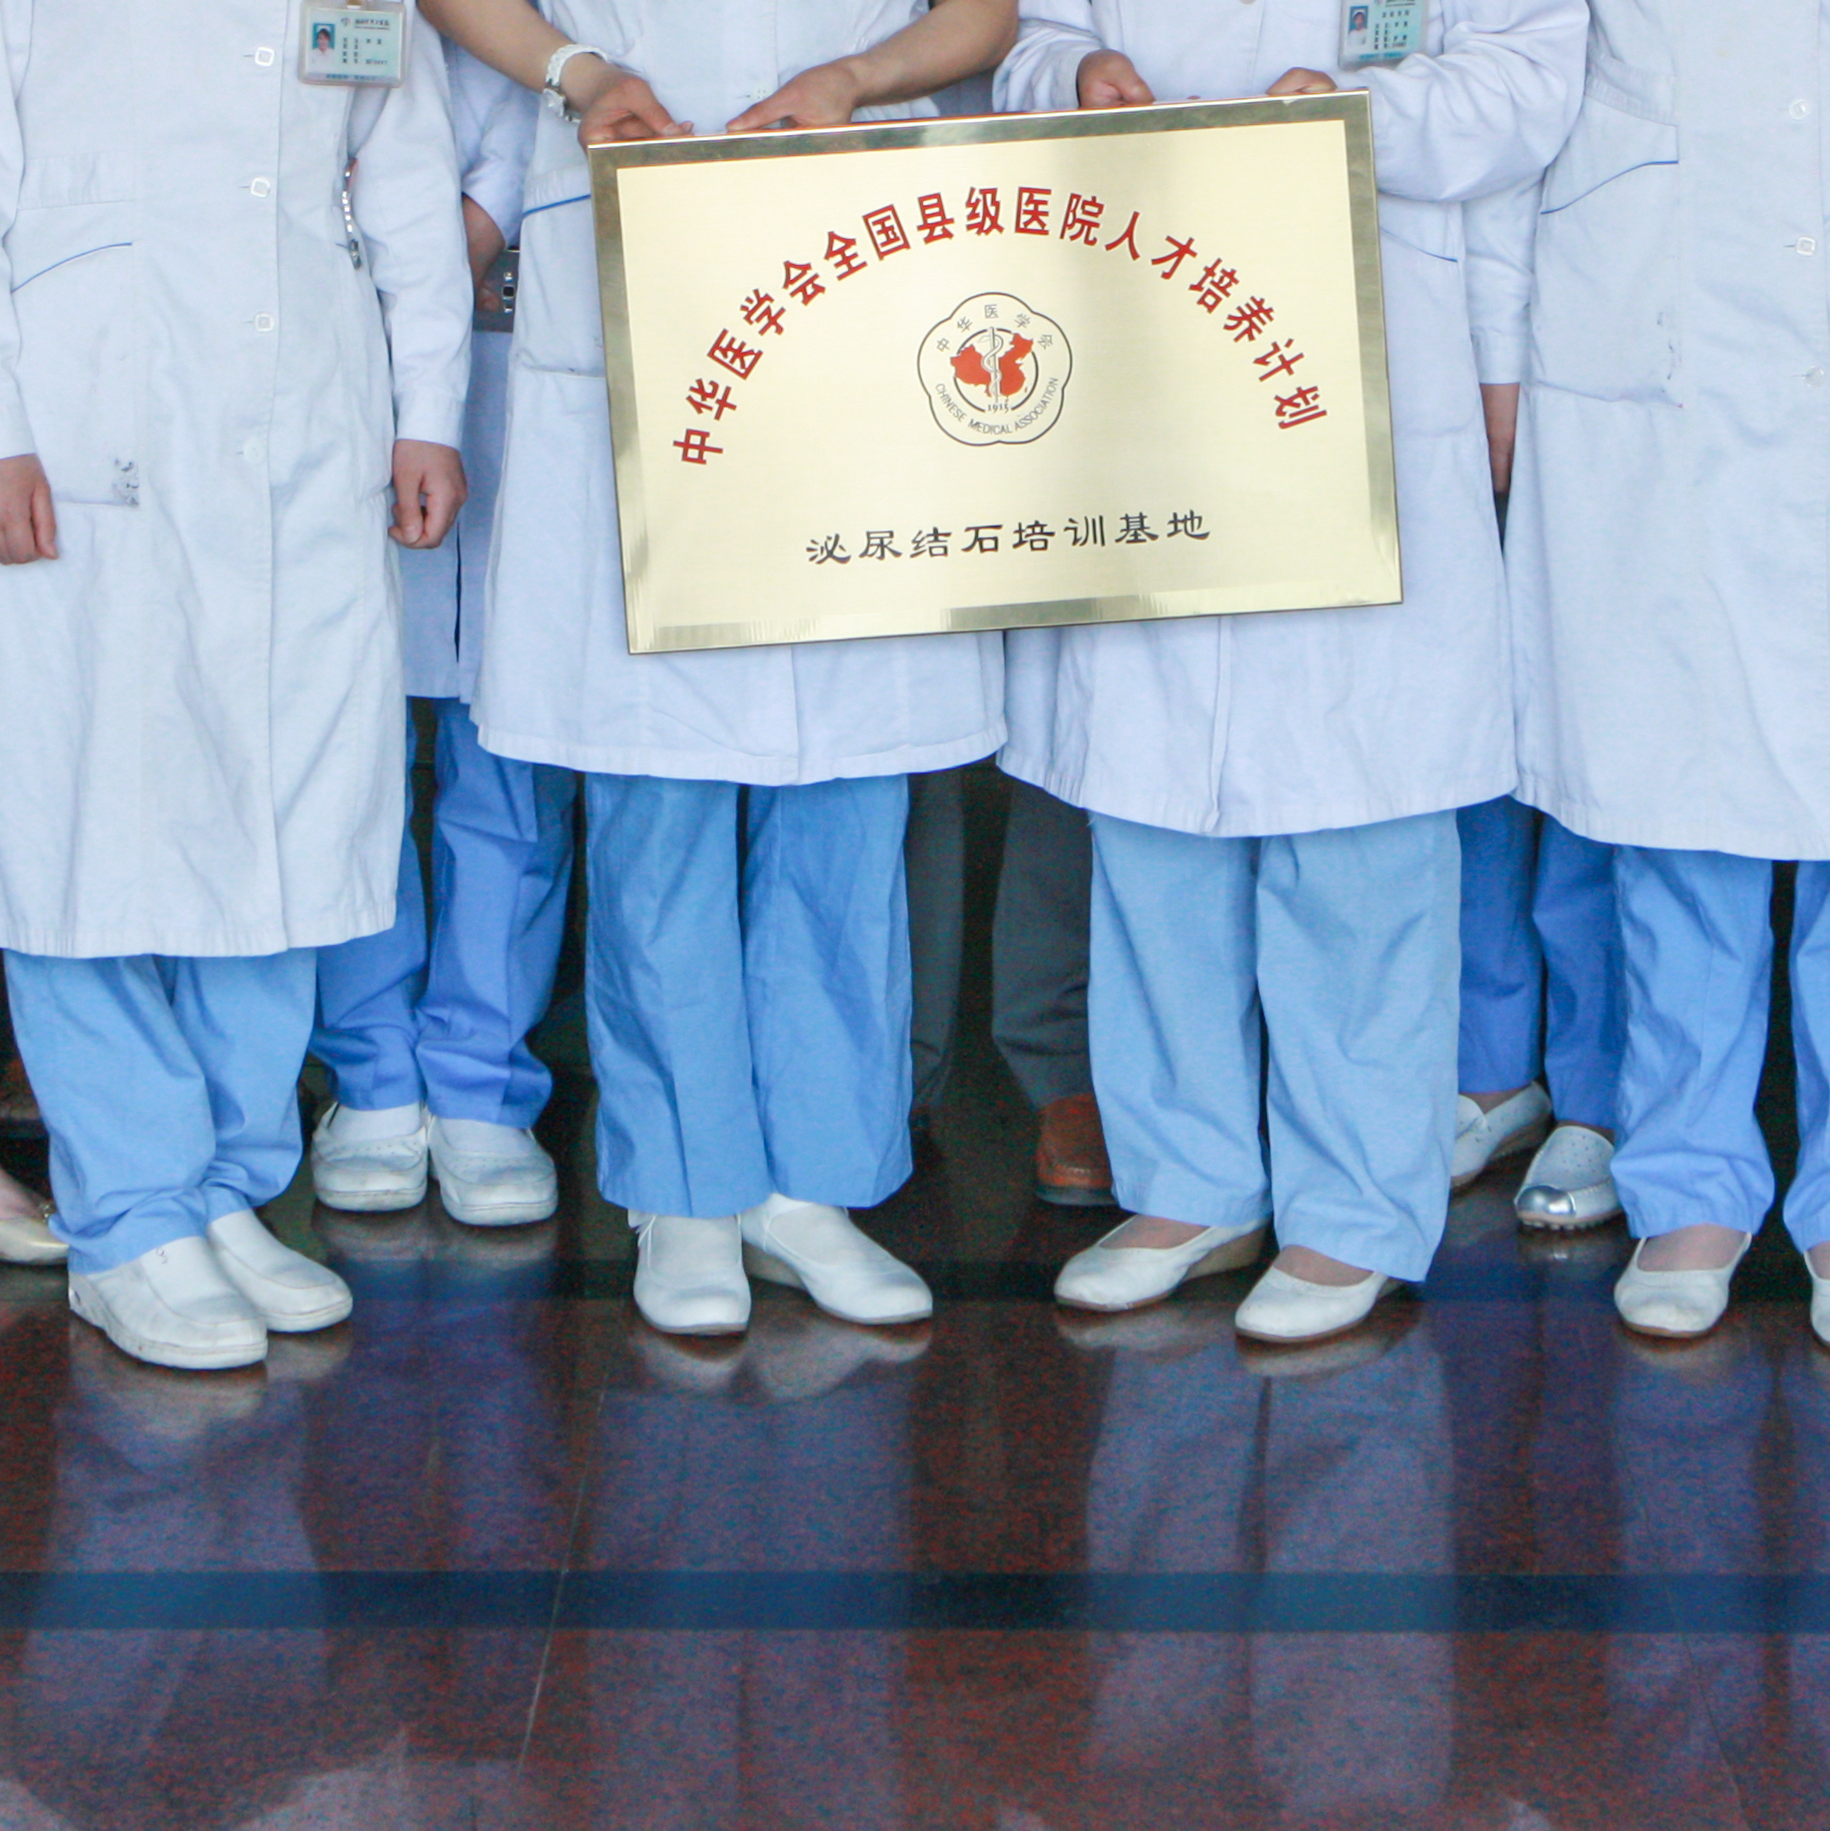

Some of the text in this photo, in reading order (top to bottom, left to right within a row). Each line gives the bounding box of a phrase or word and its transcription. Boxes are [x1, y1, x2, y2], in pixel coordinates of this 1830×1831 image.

[671, 186, 1329, 467] 中华医学会全国县级医院人才培养计划
[936, 303, 1054, 353] 中华医学会
[935, 377, 1060, 436] CHINESE MEDICAL ASSOCIATION
[804, 508, 1212, 565] 泌尿结石培训基地
